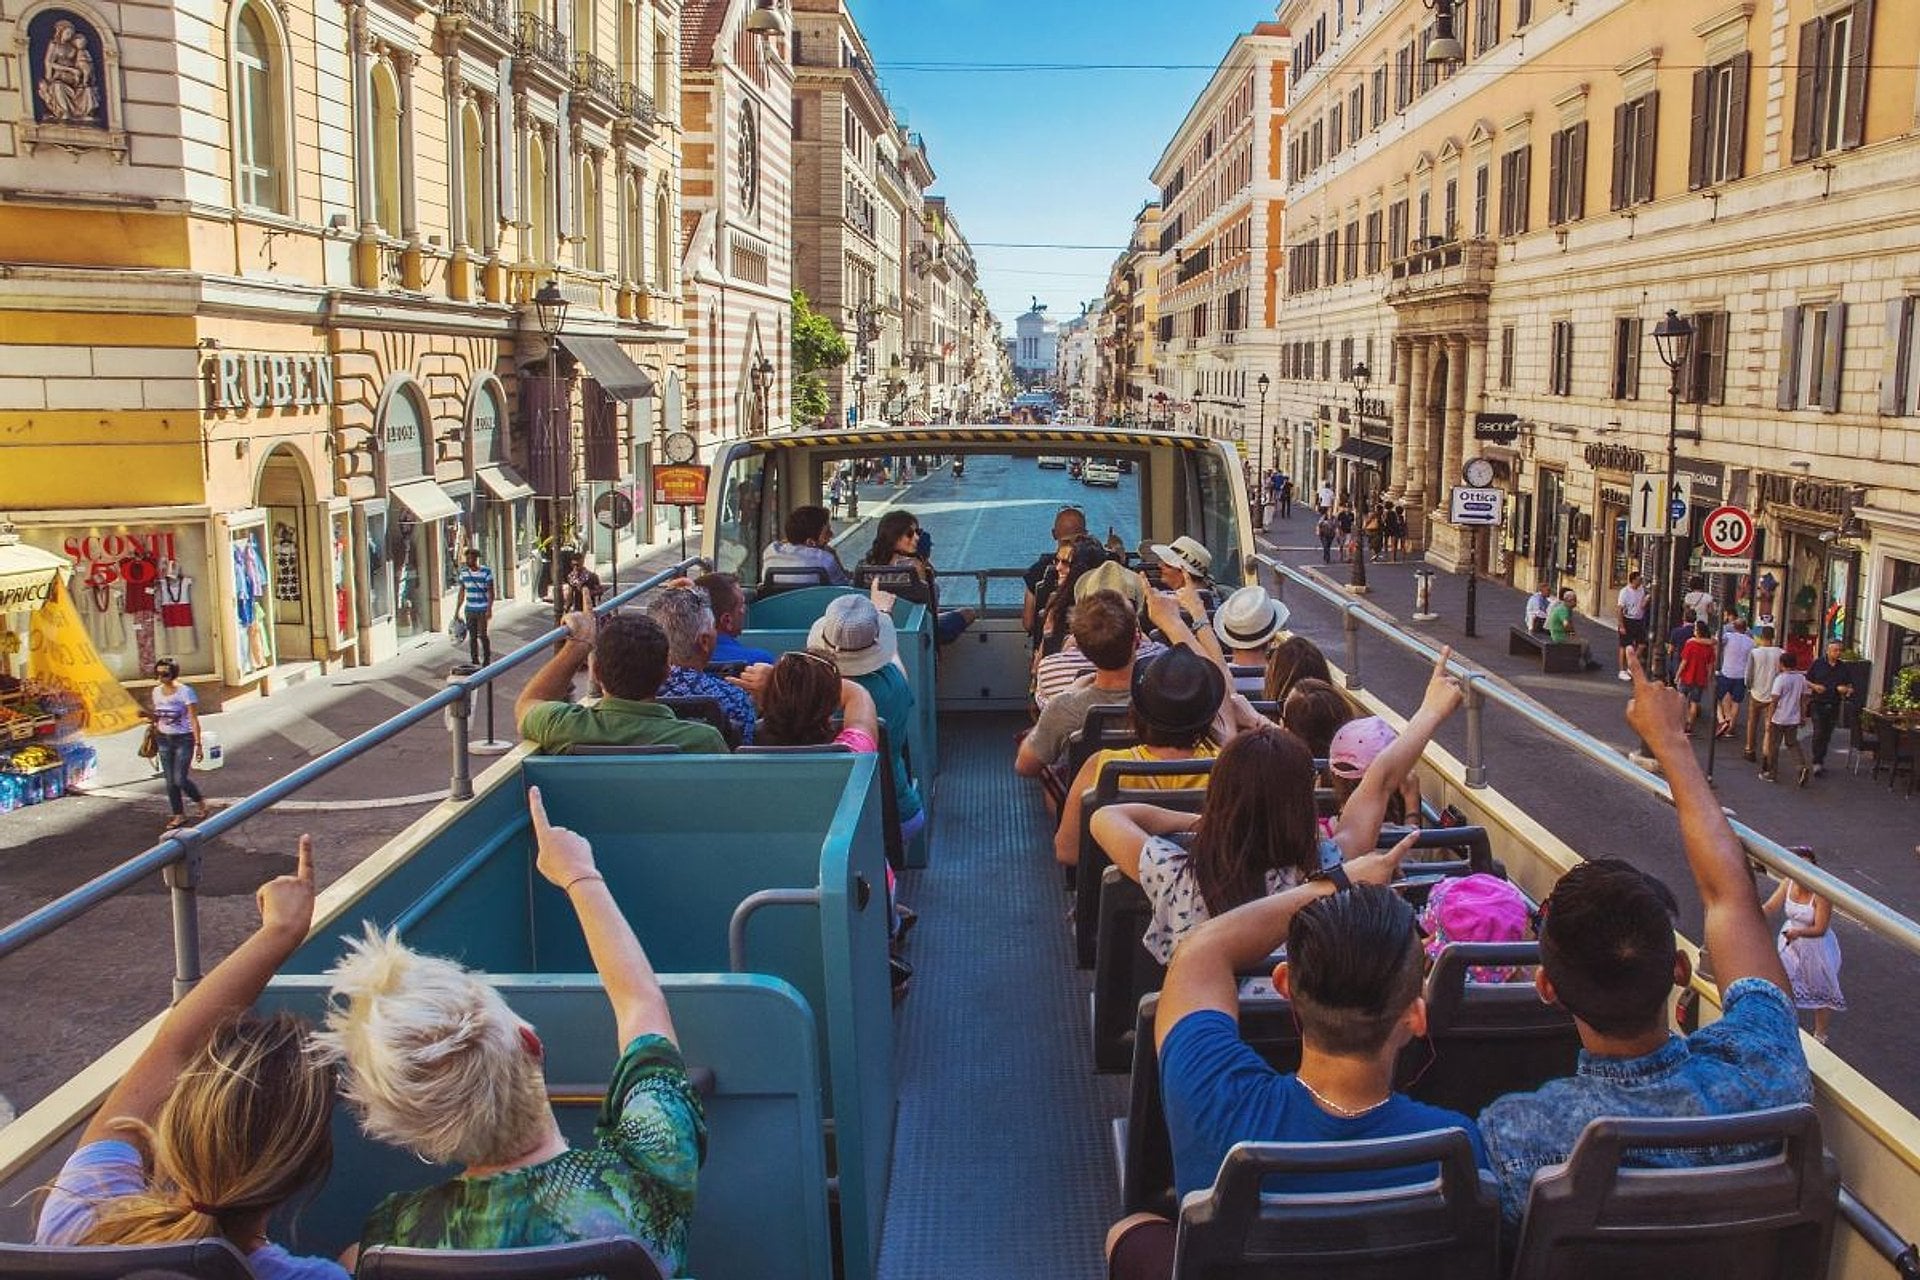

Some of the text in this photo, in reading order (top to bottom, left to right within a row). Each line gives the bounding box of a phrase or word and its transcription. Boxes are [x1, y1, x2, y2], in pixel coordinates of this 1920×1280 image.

[219, 353, 333, 407] RUBEN
[1459, 491, 1497, 502] Ottica
[1715, 520, 1743, 542] 30
[64, 532, 175, 563] SCONTI
[84, 559, 156, 586] 50
